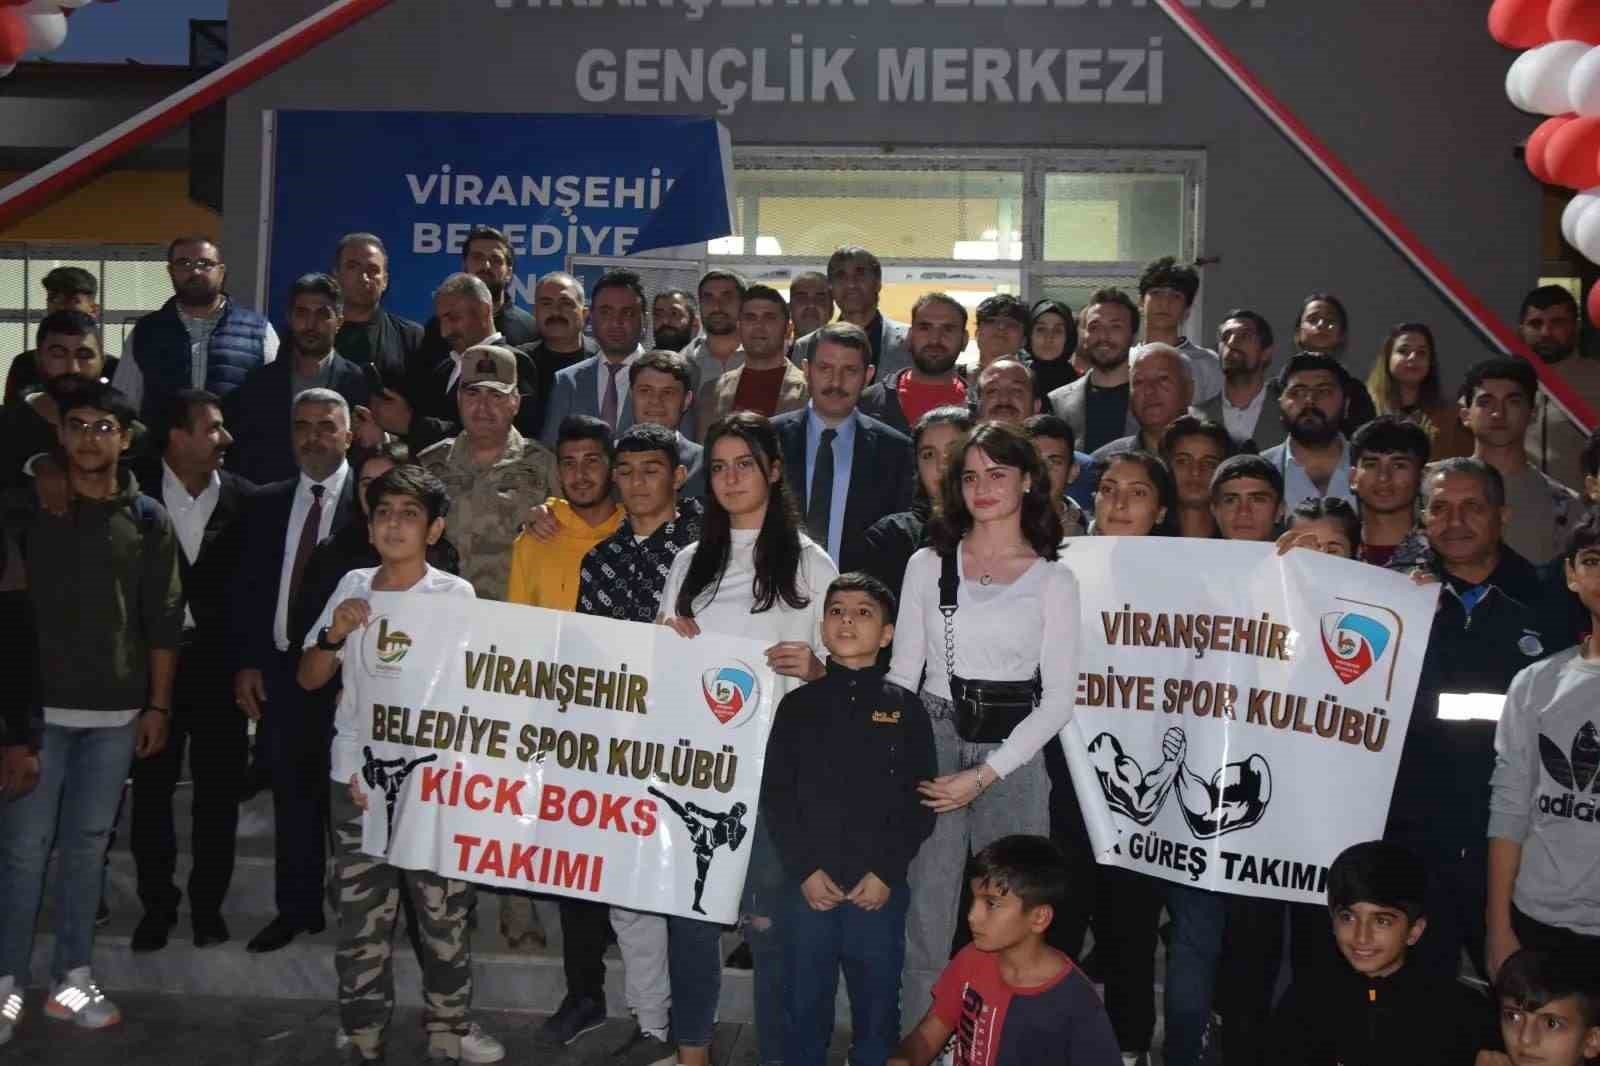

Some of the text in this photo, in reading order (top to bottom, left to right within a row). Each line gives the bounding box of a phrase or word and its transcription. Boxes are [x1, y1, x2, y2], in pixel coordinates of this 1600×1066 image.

[575, 34, 1164, 115] GENÇLİK MERKEZİ
[412, 215, 640, 256] BEEDİYE
[1101, 604, 1291, 660] VİRANŞEHİR
[464, 644, 649, 715] VİRANŞEHİR
[371, 705, 738, 794] BELEDİYE SPOR KULÜBÜ
[1162, 678, 1238, 721] SPOR
[1246, 687, 1390, 753] KULÜBÜ
[420, 762, 658, 837] KİCK BOKS
[453, 834, 604, 893] TAKIMI
[1129, 830, 1208, 881] GÜREŞ
